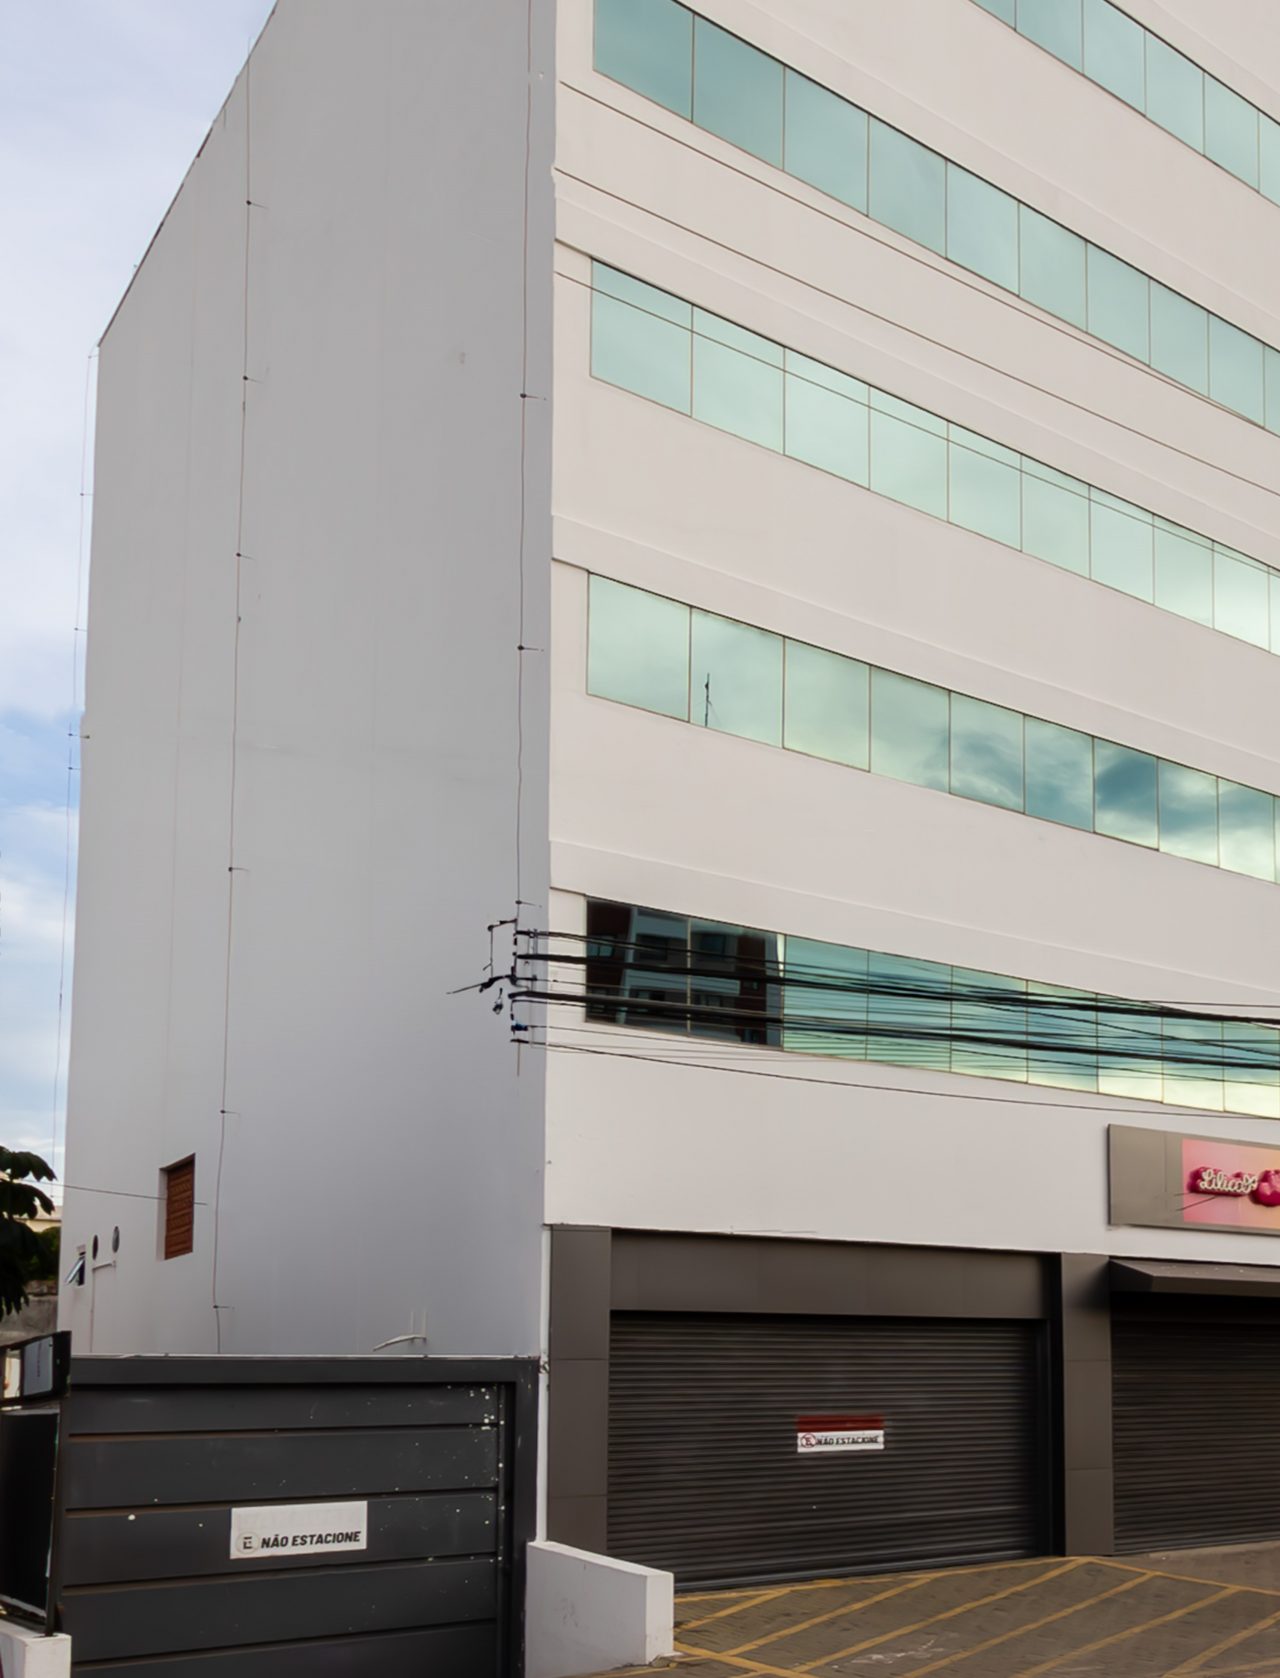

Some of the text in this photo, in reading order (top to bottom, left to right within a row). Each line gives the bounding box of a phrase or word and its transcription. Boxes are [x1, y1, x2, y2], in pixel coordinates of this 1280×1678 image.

[836, 1435, 880, 1445] ESTACIONE
[261, 1534, 289, 1549] NÃO
[291, 1530, 362, 1547] ESTACIONE
